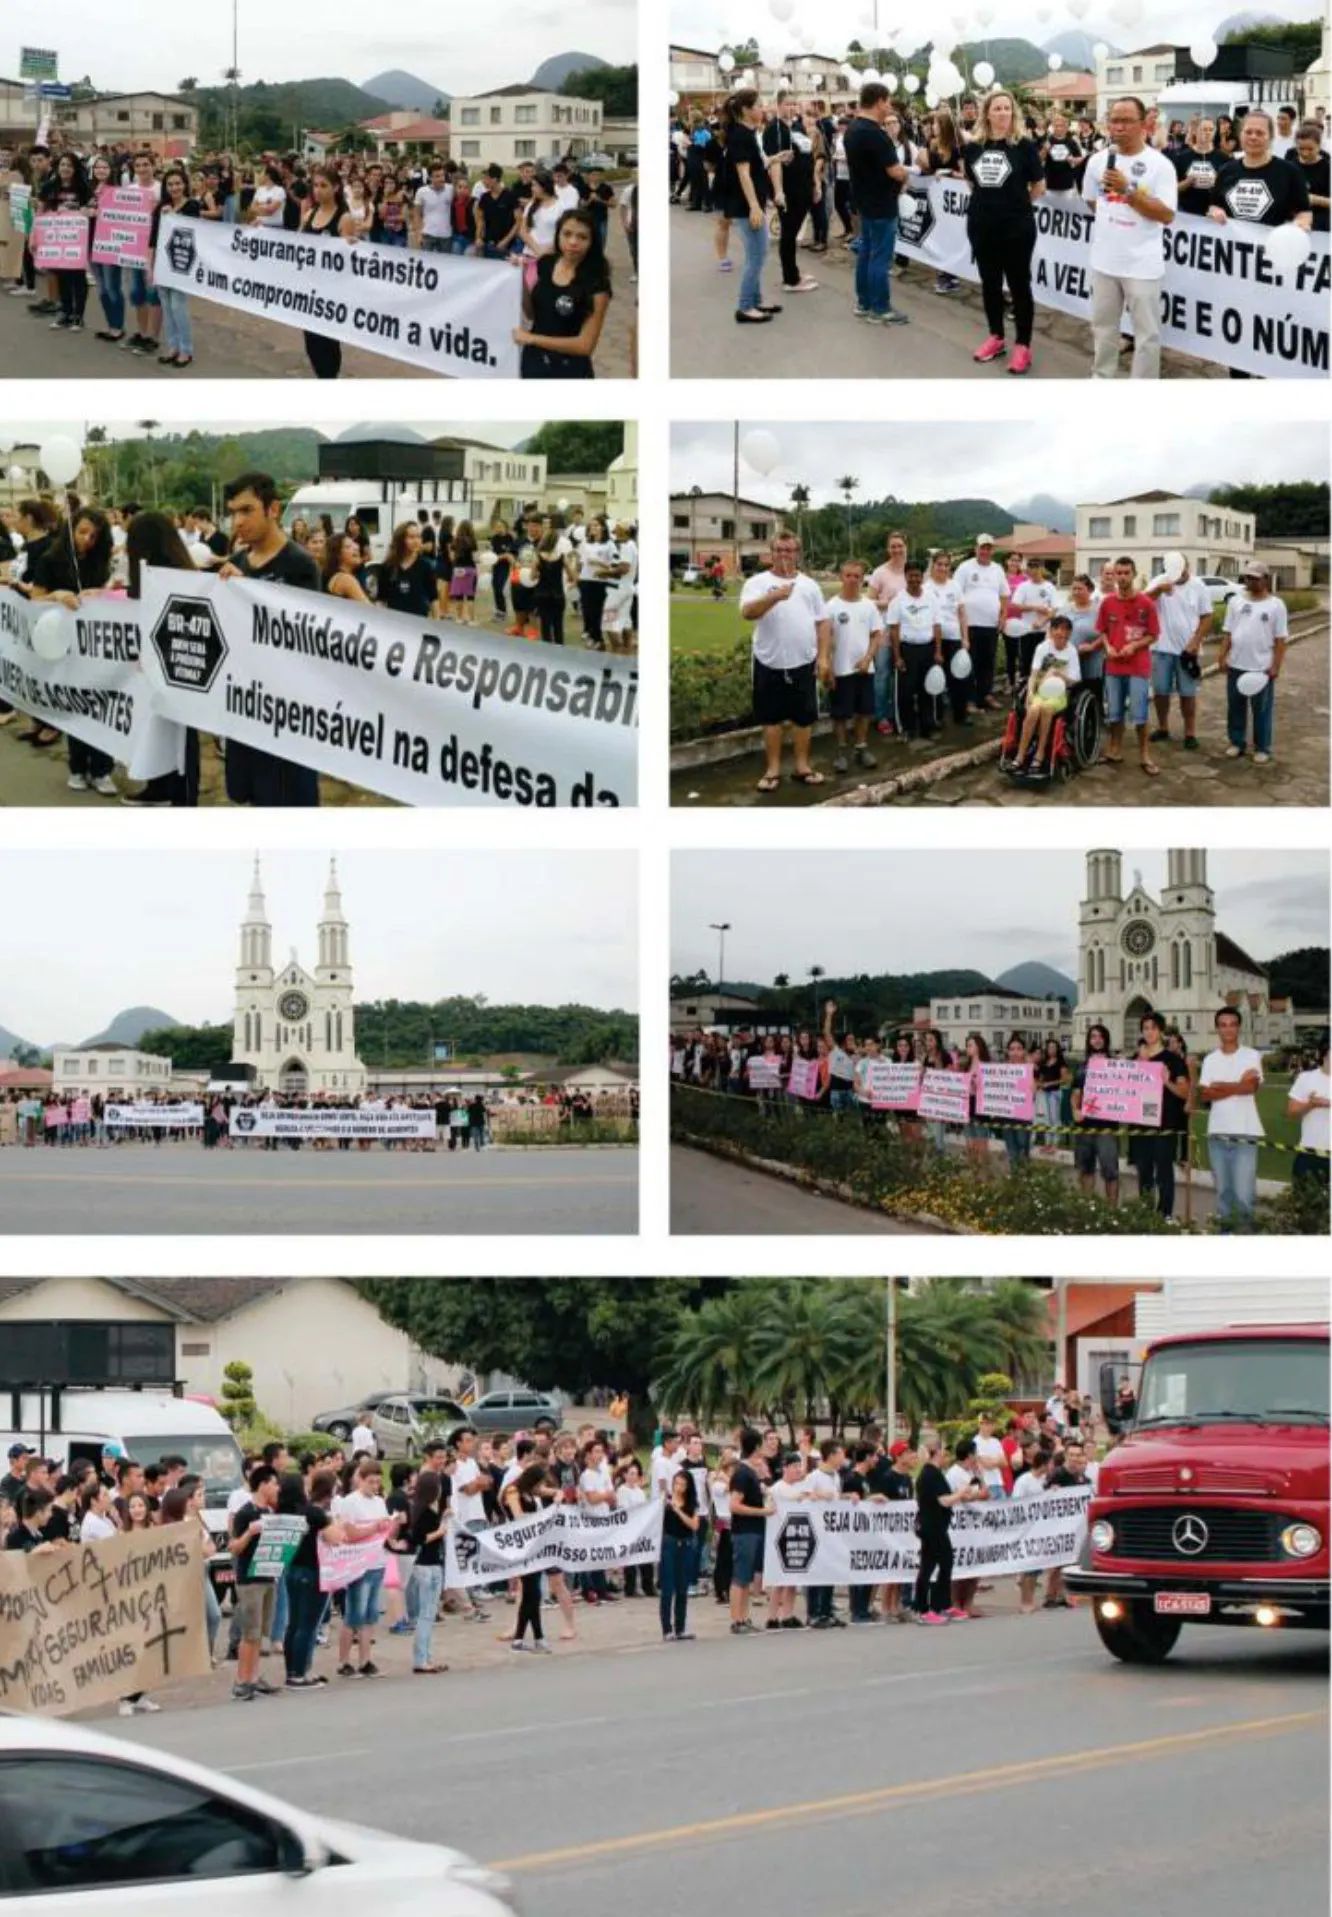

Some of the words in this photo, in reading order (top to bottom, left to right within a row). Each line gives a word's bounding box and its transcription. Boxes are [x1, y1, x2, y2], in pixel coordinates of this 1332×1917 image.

[231, 228, 316, 271] Segurança
[321, 250, 345, 272] no
[350, 250, 439, 291] trânsito
[208, 269, 228, 291] um
[232, 276, 348, 324] compromisso
[353, 307, 400, 340] com
[407, 321, 422, 346] a
[429, 322, 497, 367] vida.
[1196, 301, 1213, 337] E
[1222, 308, 1242, 344] O
[167, 611, 212, 638] BR-470
[253, 603, 378, 671] Mobilidade
[385, 641, 406, 677] e
[413, 633, 638, 728] Responsabi
[225, 673, 385, 761] indispensável
[392, 729, 430, 774] na
[440, 734, 557, 807] defesa
[823, 1511, 850, 1533] SEJA
[43, 1582, 169, 1665] SEGURANÇA
